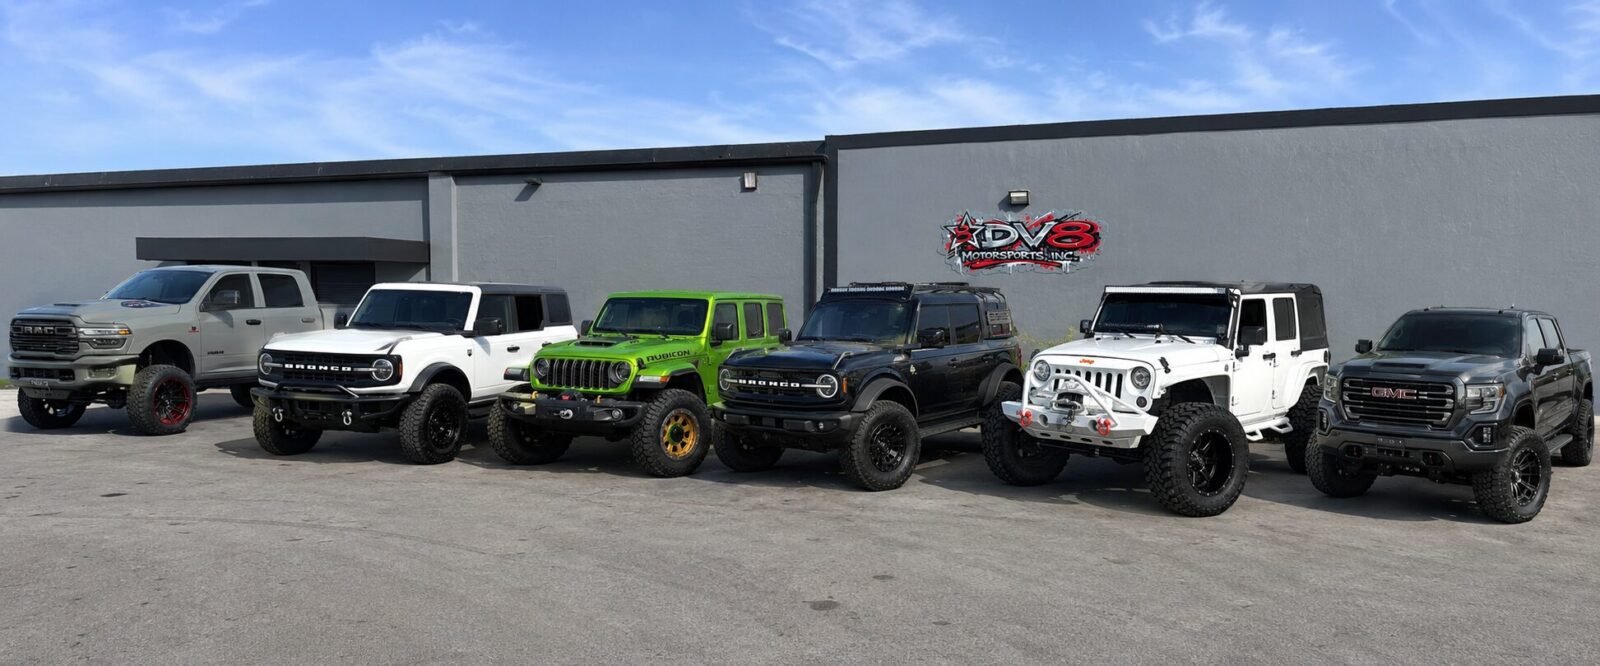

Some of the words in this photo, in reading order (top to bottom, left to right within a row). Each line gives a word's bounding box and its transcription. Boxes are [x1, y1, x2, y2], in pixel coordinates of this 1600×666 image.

[981, 221, 1095, 249] DV8
[961, 250, 1048, 261] MOTORSPORTS,
[1051, 251, 1078, 261] INC.
[646, 350, 690, 362] RUBICON
[284, 363, 352, 372] BRONCO
[738, 379, 800, 388] BRONCO
[1371, 387, 1417, 400] GMC
